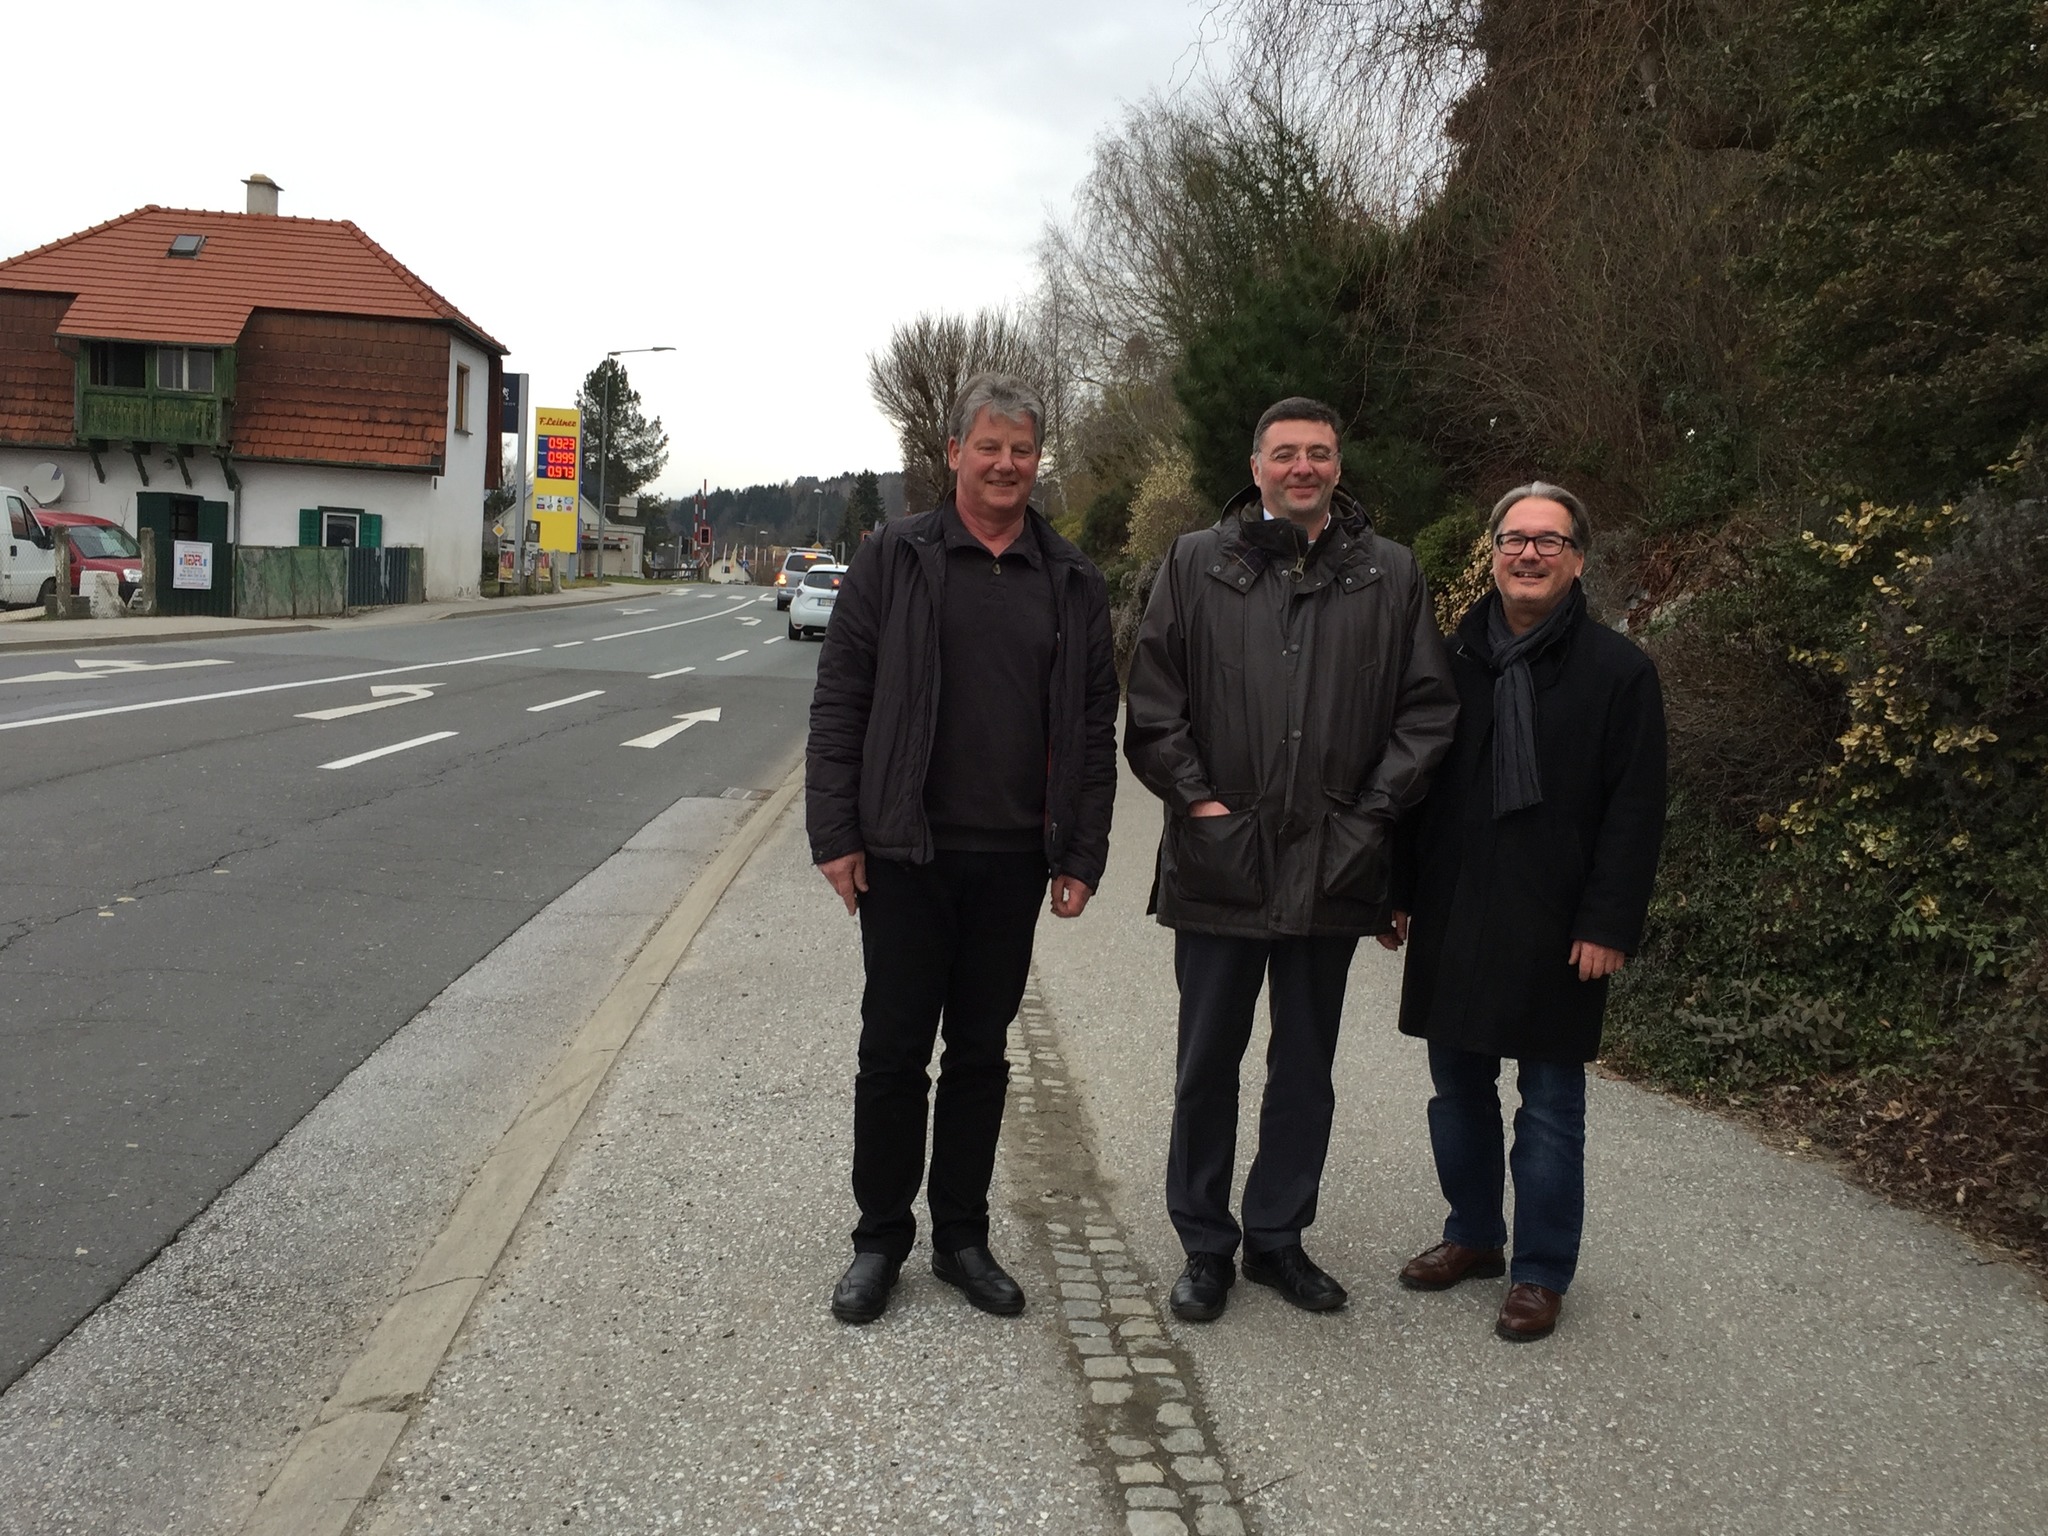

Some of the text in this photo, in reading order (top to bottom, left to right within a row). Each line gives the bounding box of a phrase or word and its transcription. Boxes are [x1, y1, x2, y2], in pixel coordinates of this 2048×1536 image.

[548, 437, 575, 450] 0.923
[547, 451, 575, 465] 0.999
[547, 465, 574, 479] 0.973
